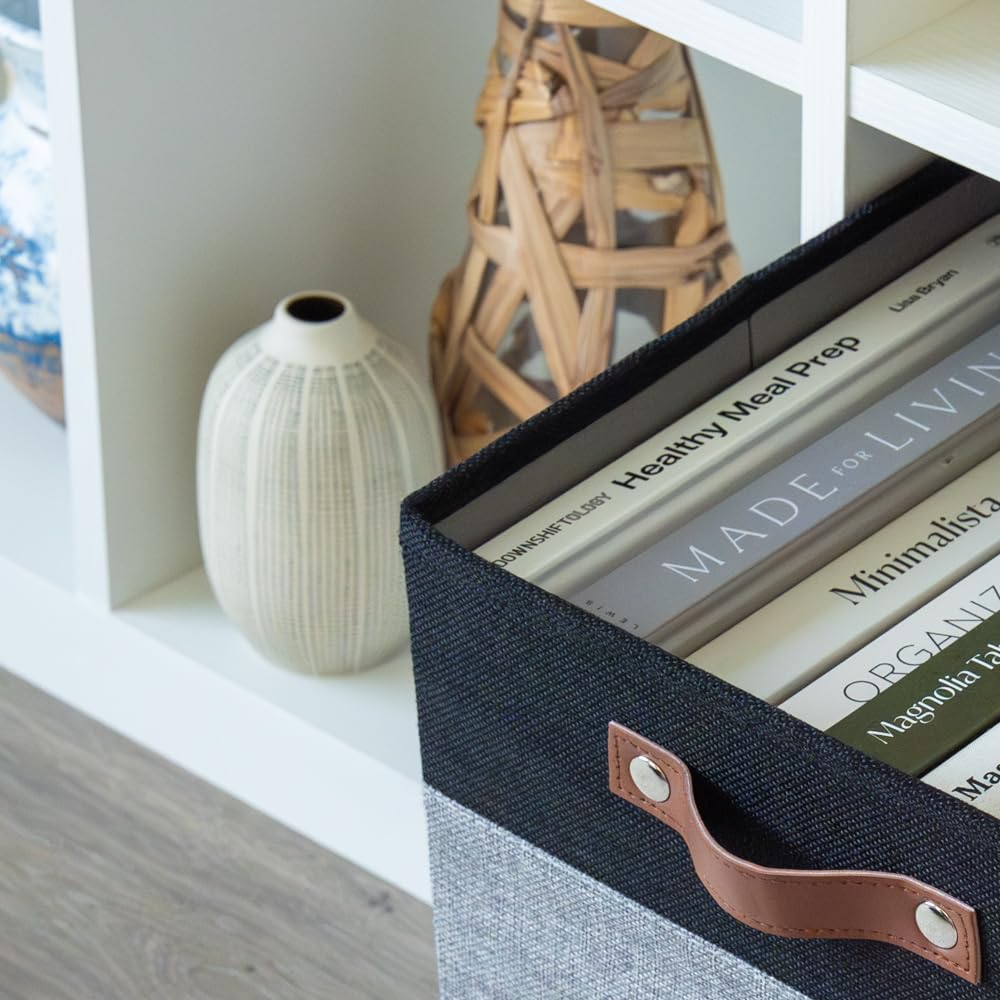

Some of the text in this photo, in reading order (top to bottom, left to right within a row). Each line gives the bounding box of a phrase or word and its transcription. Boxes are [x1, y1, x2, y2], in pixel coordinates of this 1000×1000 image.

[916, 269, 959, 296] Bryan
[611, 335, 861, 490] Healthy Meal Prep
[661, 472, 839, 584] MADE
[831, 449, 873, 477] FOR
[866, 669, 983, 746] Magnolia
